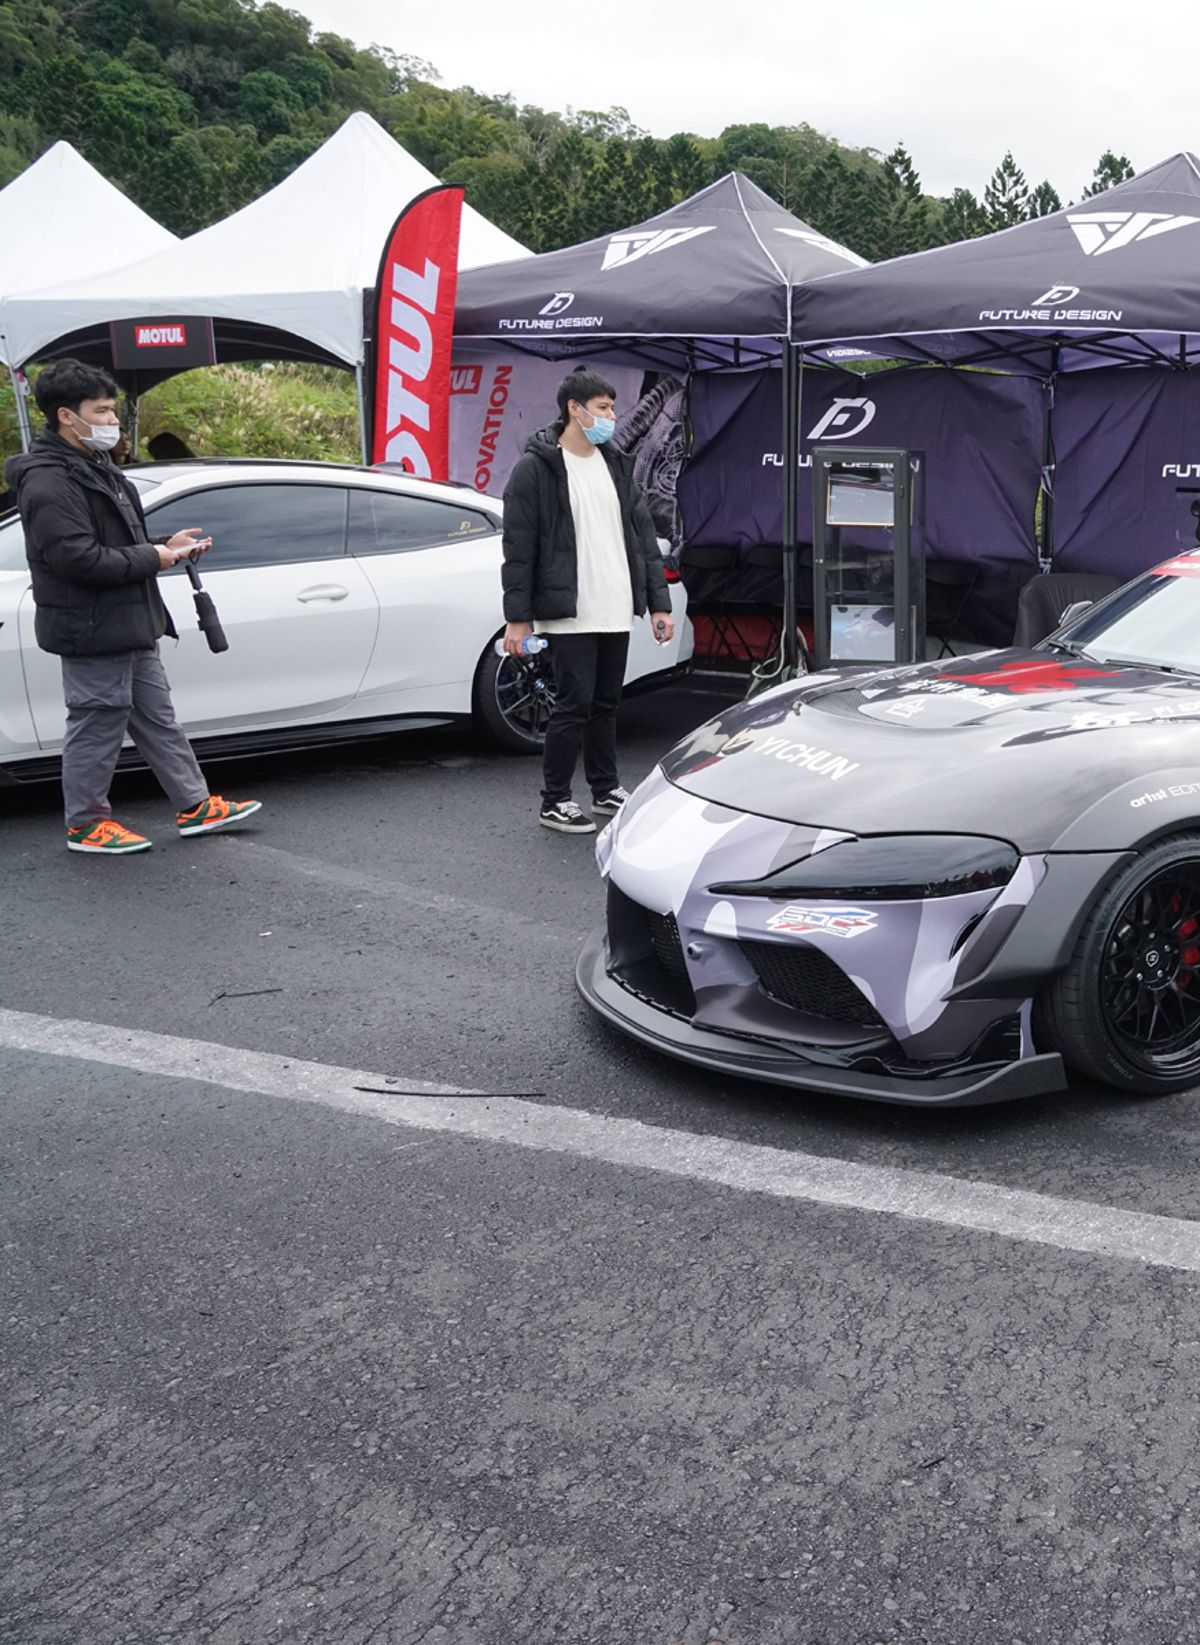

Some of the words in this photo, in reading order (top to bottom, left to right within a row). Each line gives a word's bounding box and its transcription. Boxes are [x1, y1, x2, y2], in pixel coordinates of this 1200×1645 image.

[499, 319, 554, 329] FUTURE
[555, 316, 603, 328] DESIGN
[979, 310, 1050, 321] FUTURE
[1054, 310, 1122, 321] DESIGN
[138, 327, 184, 344] MOTUL
[385, 258, 440, 481] OTUL
[474, 365, 513, 494] OVATION
[754, 736, 860, 781] YICHUN
[1130, 789, 1168, 808] artist
